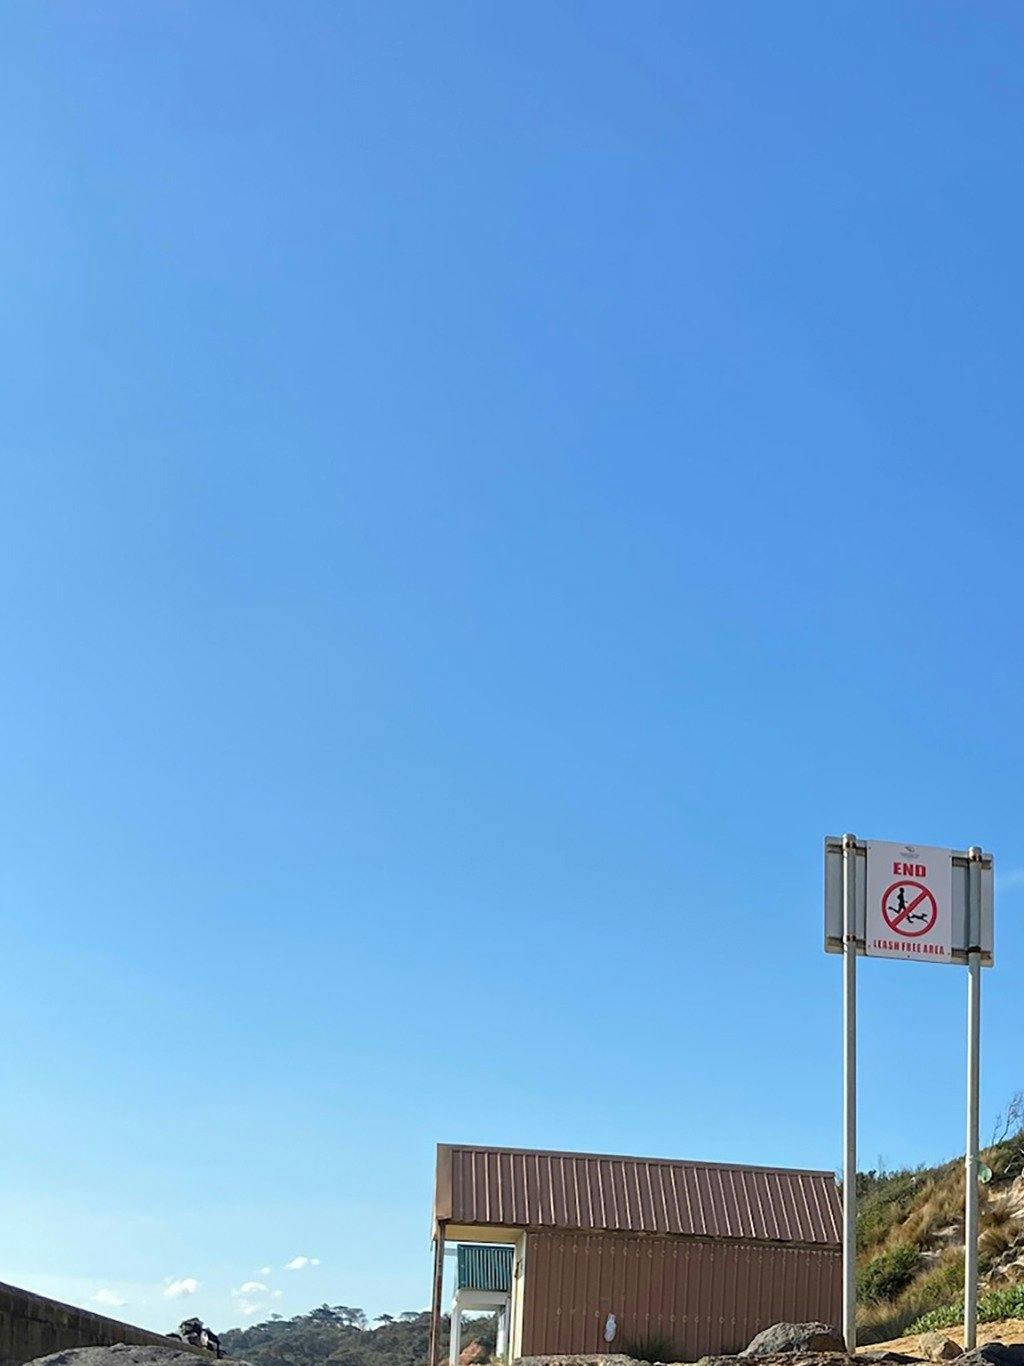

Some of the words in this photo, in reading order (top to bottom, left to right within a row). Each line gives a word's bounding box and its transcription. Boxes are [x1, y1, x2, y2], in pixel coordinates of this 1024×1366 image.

[893, 862, 926, 877] END
[873, 939, 899, 951] LEASH
[902, 942, 921, 953] FREE
[923, 944, 945, 955] AREA
